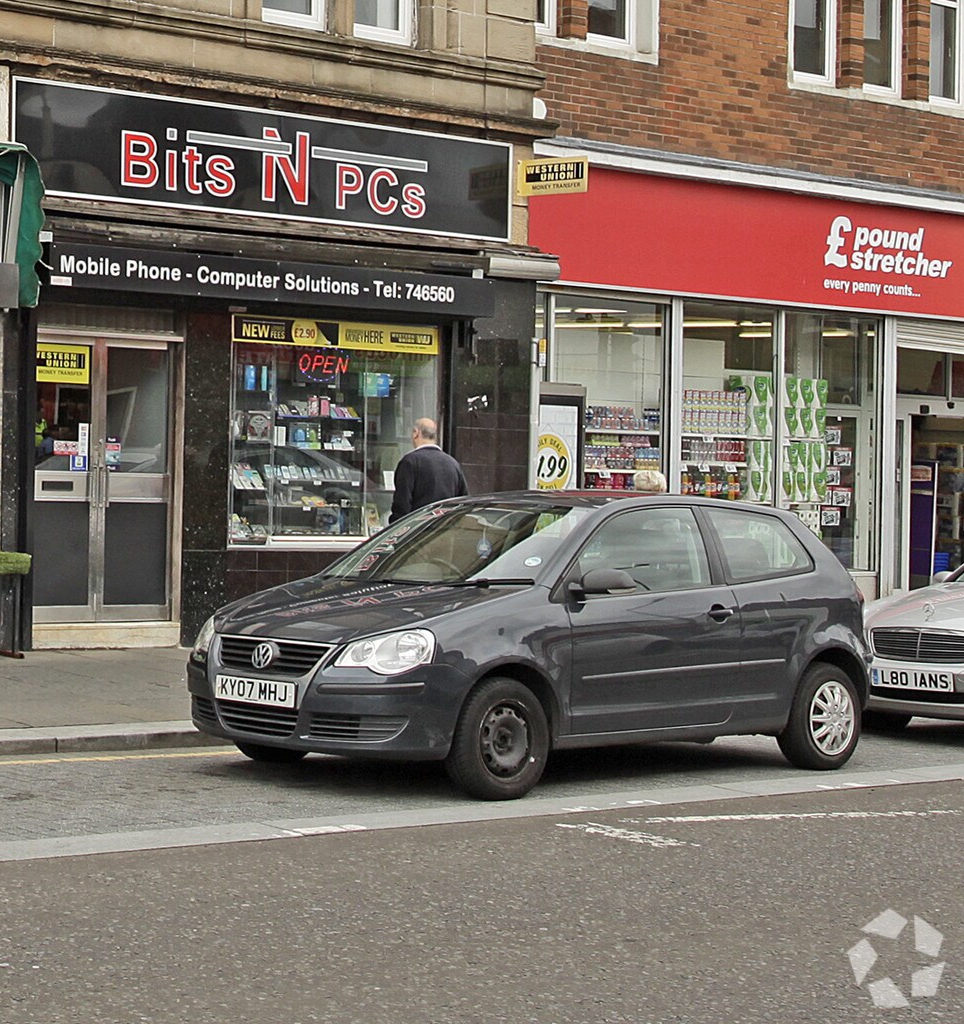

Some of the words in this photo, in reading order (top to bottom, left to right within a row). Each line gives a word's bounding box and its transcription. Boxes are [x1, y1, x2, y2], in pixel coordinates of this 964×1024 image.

[121, 128, 235, 197] Bits
[262, 127, 310, 206] N
[336, 163, 426, 219] PCs
[526, 163, 574, 175] WESTERN
[540, 171, 574, 181] UNION
[531, 183, 551, 191] MONEY
[853, 226, 925, 252] pound
[850, 247, 953, 278] stretcher
[60, 254, 121, 277] Mobile
[126, 259, 182, 282] Phone
[197, 265, 280, 291] Computer
[285, 273, 360, 296] Solutions
[373, 280, 402, 299] Tel:
[405, 284, 455, 303] 746560
[823, 278, 850, 294] every
[852, 281, 881, 297] penny
[883, 284, 921, 297] counts...
[242, 323, 270, 338] NEW
[270, 330, 285, 339] FEES
[294, 327, 315, 339] £2.90
[364, 330, 384, 344] HERE
[46, 359, 76, 367] UNION
[299, 353, 350, 374] OPEN
[220, 678, 255, 698] KY07
[258, 682, 288, 702] MHJ
